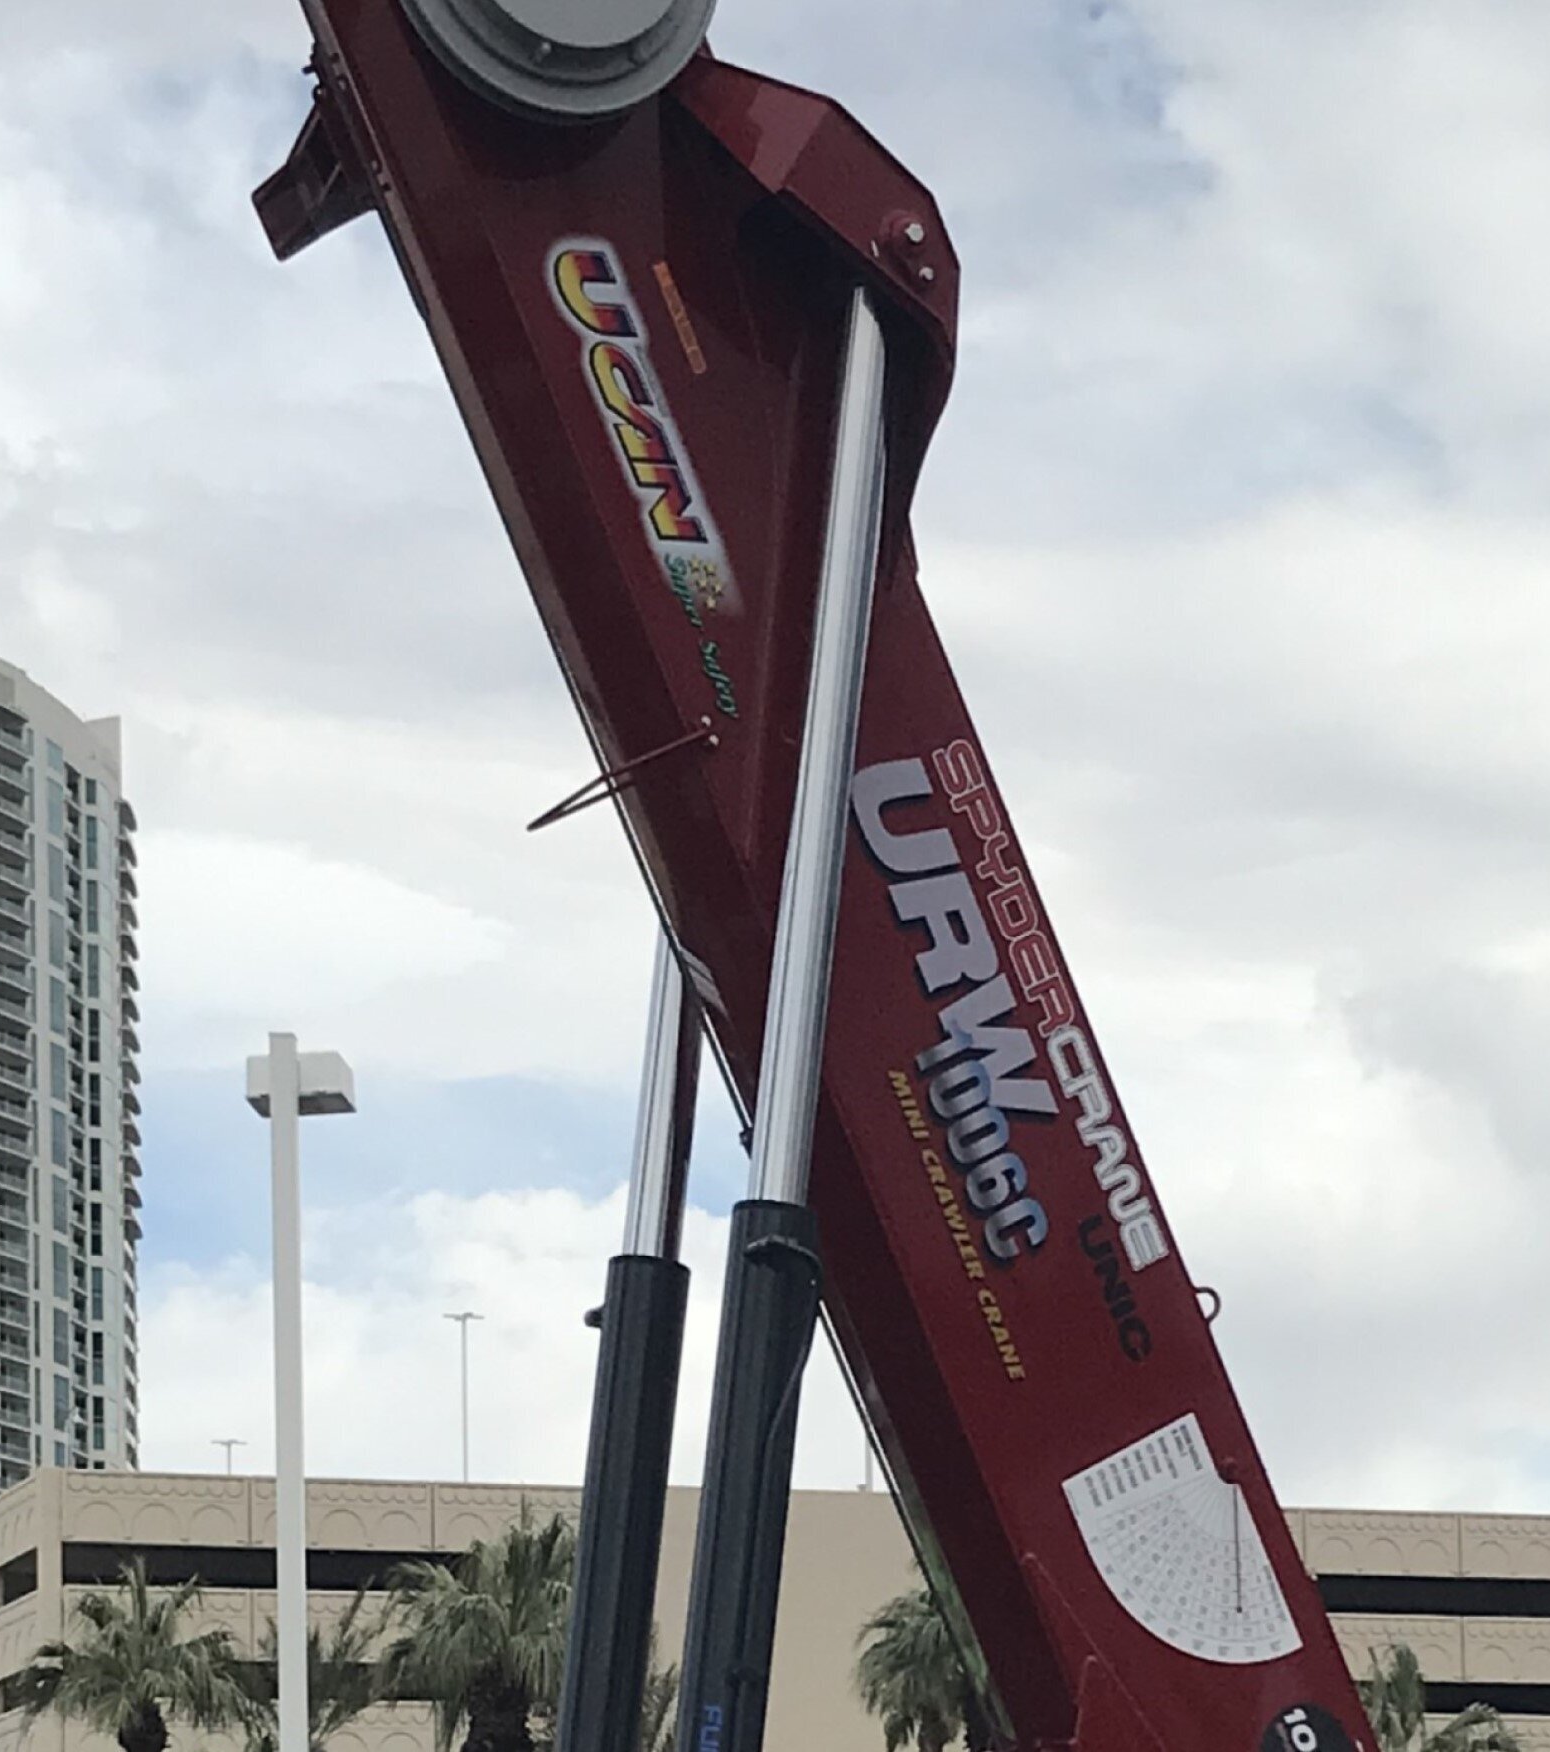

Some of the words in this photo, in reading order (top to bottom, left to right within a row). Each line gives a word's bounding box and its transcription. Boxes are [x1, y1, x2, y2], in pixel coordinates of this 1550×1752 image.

[553, 248, 708, 544] UCAN
[851, 757, 1060, 1114] URW
[887, 1069, 930, 1140] MINI
[921, 1148, 985, 1281] CRAWLER
[977, 1287, 1026, 1382] CRANE
[914, 1017, 1049, 1260] 1006C
[1078, 1212, 1152, 1362] UNIC
